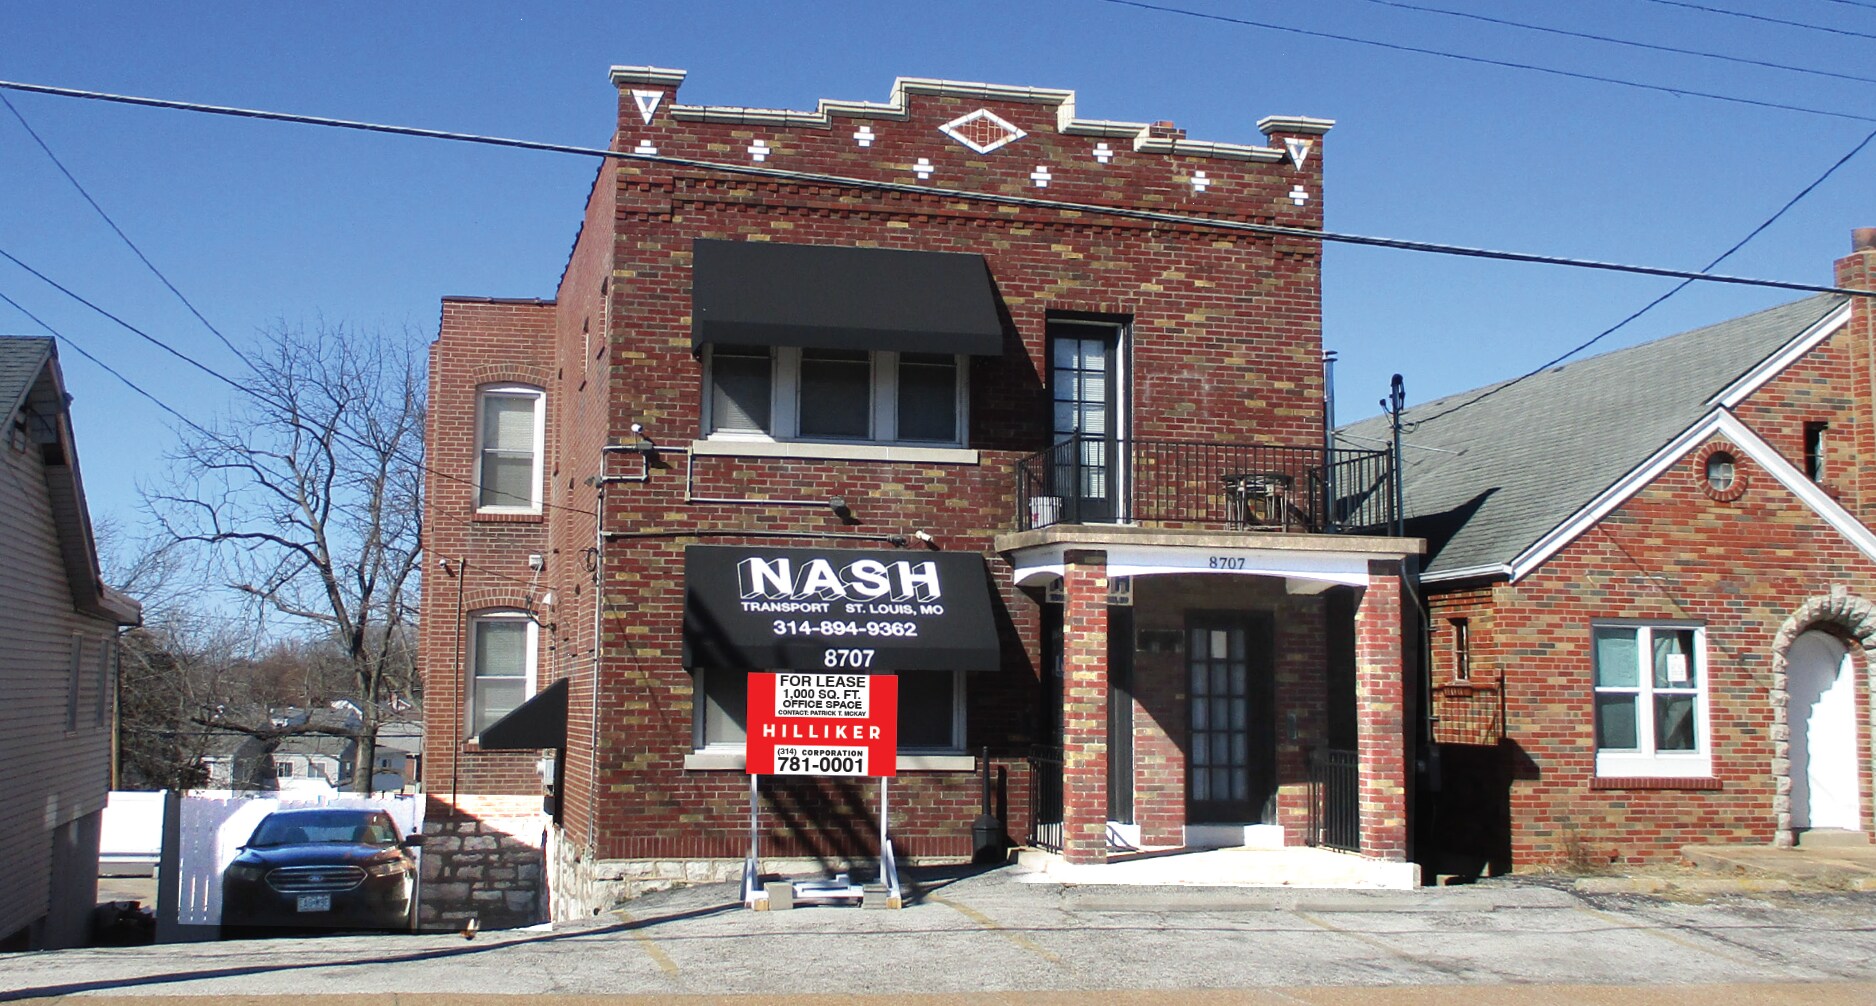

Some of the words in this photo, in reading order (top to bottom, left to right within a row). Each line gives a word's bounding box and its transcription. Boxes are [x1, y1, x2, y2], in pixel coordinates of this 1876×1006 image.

[1209, 556, 1246, 570] 8707
[737, 557, 941, 602] NASH
[741, 602, 830, 613] TRANSPORT
[845, 603, 866, 613] ST.
[869, 604, 917, 615] LOUIS,
[920, 605, 944, 615] MO
[773, 620, 918, 637] 314-894-9362
[824, 649, 875, 668] 8707
[780, 675, 812, 687] FOR
[816, 676, 866, 688] LEASE
[783, 689, 815, 700] 1,000
[818, 689, 840, 699] SQ.
[844, 690, 861, 700] FT.
[783, 700, 823, 708] OFFICE
[825, 701, 862, 709] SPACE
[763, 723, 881, 740] HILLIKER
[777, 748, 797, 757] (314)
[802, 749, 863, 757] CORPORATION
[778, 756, 863, 773] 781-0001
